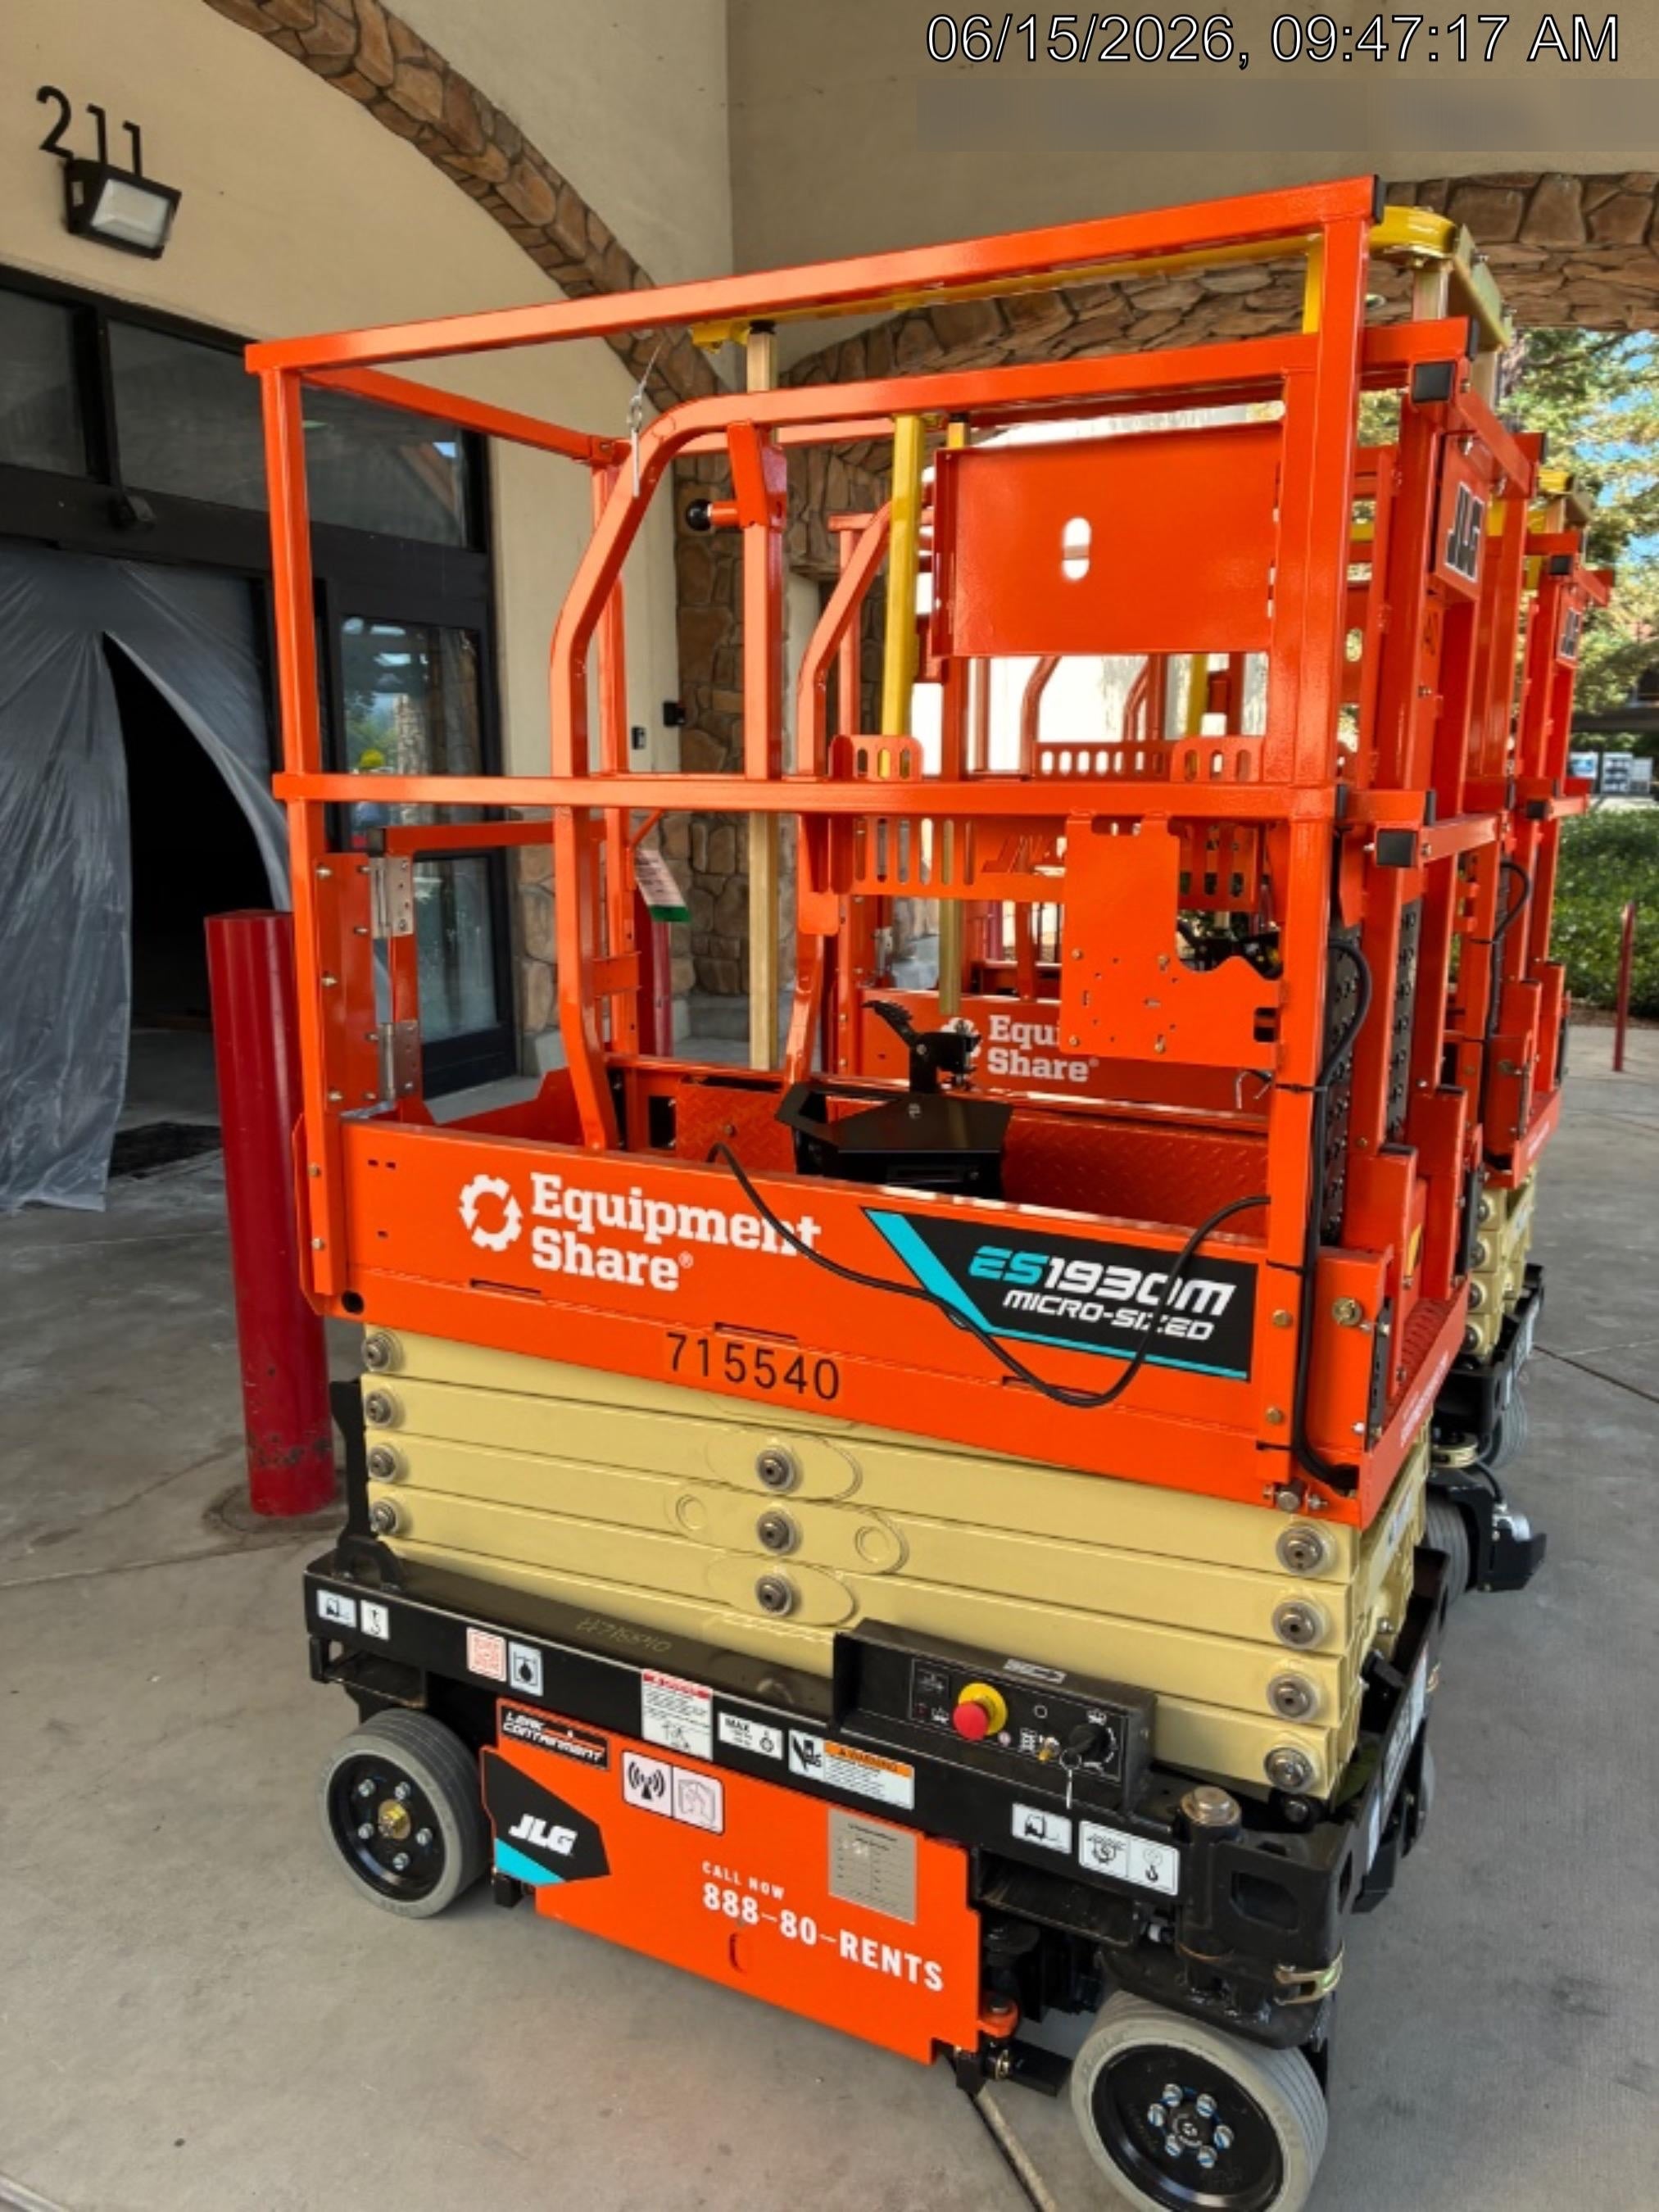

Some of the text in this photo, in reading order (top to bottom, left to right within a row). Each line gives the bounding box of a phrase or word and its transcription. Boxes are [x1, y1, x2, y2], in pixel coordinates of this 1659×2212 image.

[36, 85, 143, 178] 211
[530, 1172, 822, 1257] Equipment
[968, 1245, 1237, 1316] ES1930M
[666, 1331, 840, 1400] 715540
[508, 1812, 578, 1857] JLG
[702, 1861, 785, 1901] CALL NOW
[703, 1882, 944, 1992] 888-80-RENTS
